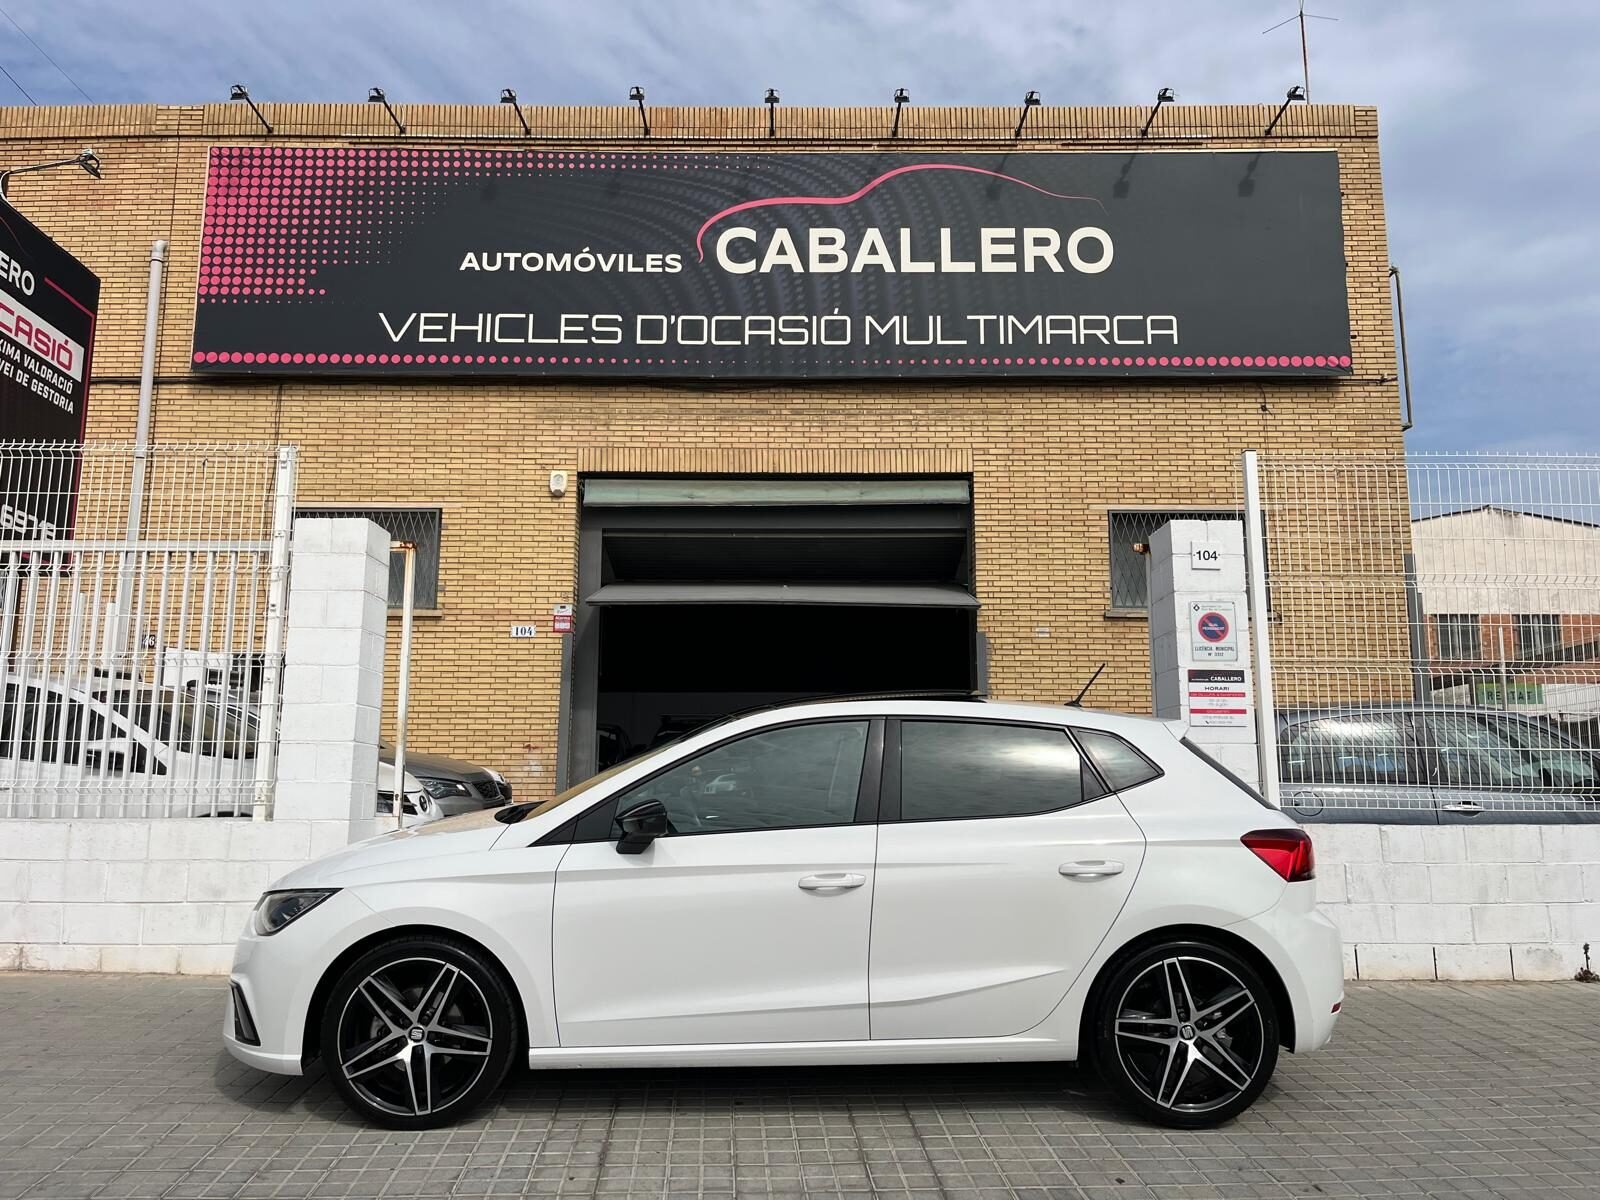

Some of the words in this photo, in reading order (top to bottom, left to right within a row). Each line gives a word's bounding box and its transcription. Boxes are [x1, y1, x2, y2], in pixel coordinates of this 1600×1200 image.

[459, 247, 683, 273] AUTOMÓVILES
[715, 226, 1115, 274] CABALLERO
[0, 249, 36, 296] ERO
[0, 302, 73, 372] CASIÓ
[378, 312, 623, 344] VEHICLES
[636, 307, 851, 346] D'OCASIÓ
[865, 314, 1179, 346] MULTIMARCA
[15, 369, 30, 387] DE
[31, 378, 74, 415] GESTORIA
[24, 353, 73, 395] VALORACIÓ
[1195, 550, 1218, 562] 104
[515, 626, 533, 636] 104
